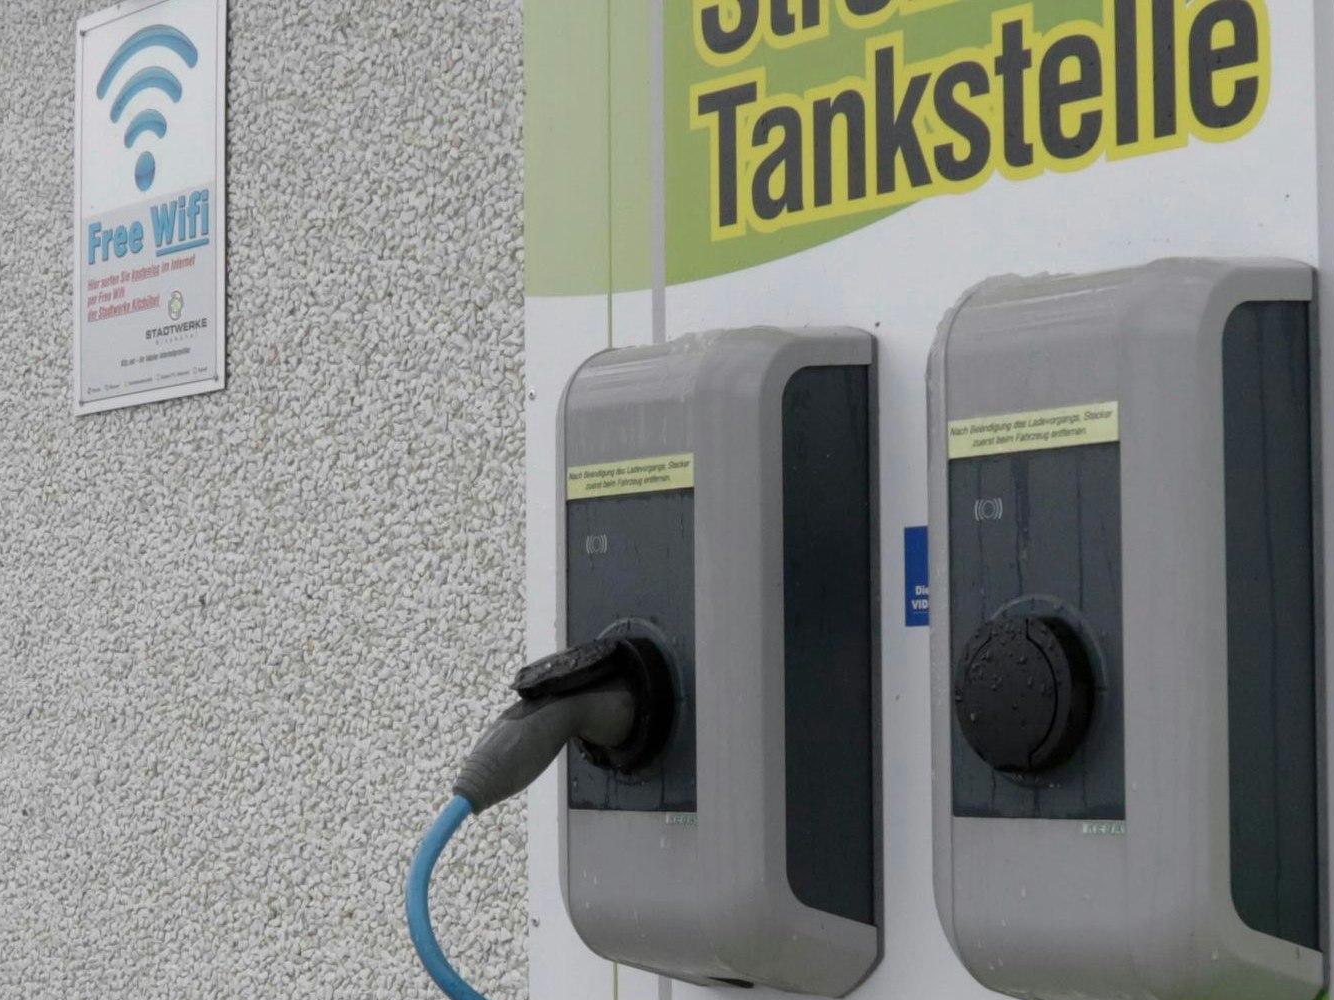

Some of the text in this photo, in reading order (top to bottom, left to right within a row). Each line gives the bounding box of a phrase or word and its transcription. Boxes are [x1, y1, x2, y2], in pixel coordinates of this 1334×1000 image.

[697, 0, 1259, 228] Tankstelle
[88, 189, 209, 265] Free Wifi
[88, 280, 100, 290] Hier
[121, 271, 131, 282] Sie
[131, 264, 160, 281] kostenlos
[162, 262, 170, 272] im
[171, 254, 196, 270] Internet
[98, 291, 112, 303] Free
[99, 301, 131, 319] Stadtwerke
[145, 318, 208, 340] STADTWERKE
[950, 427, 968, 436] Nach
[970, 422, 1012, 435] Beendigung
[1013, 419, 1027, 429] des
[1083, 410, 1113, 421] Stecker
[996, 434, 1014, 445] beim
[1015, 430, 1049, 443] Fahrzeug
